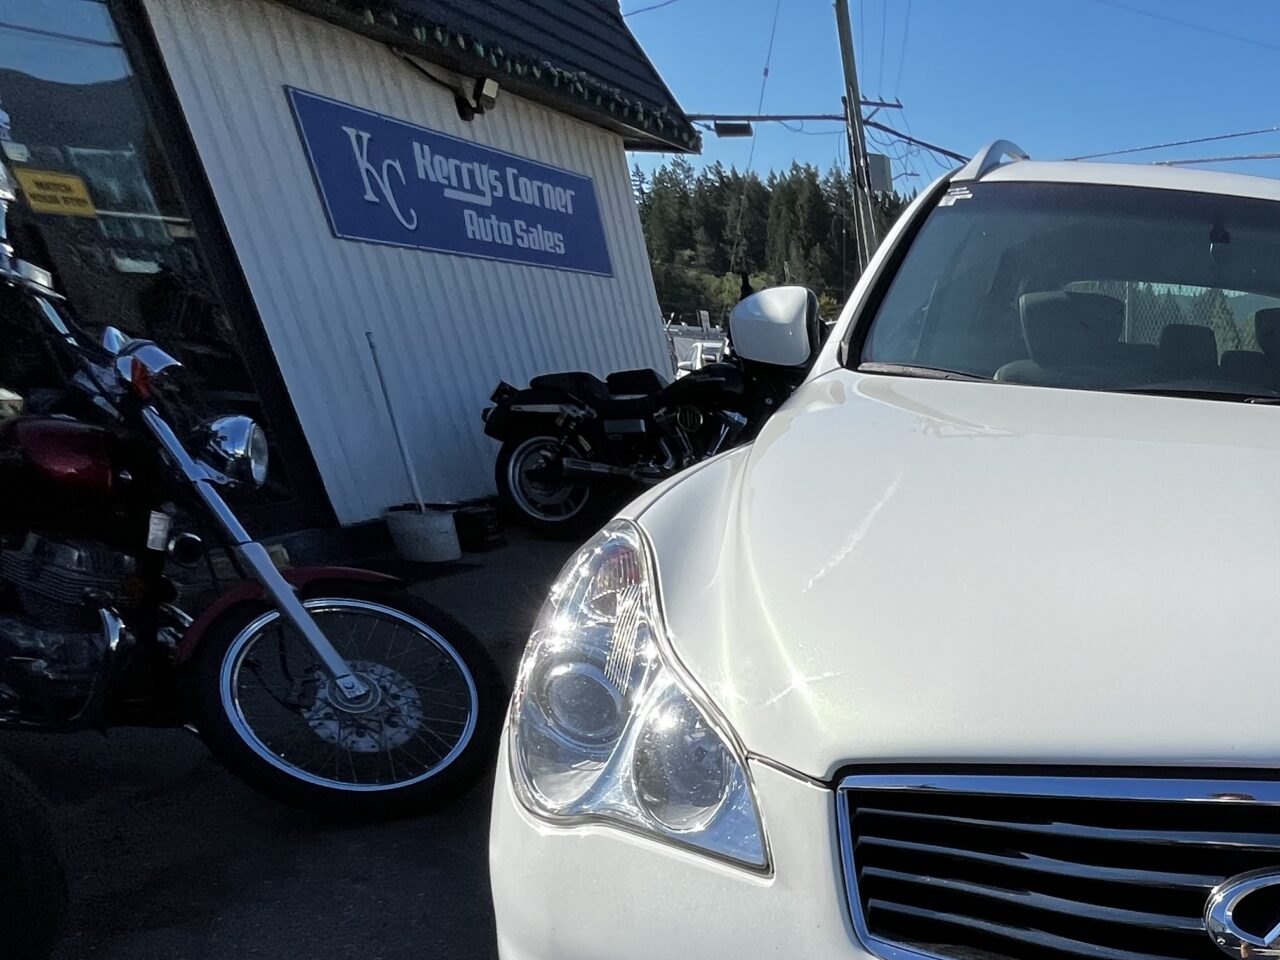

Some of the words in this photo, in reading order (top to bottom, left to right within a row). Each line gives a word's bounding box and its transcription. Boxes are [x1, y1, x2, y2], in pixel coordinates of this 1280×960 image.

[412, 141, 503, 206] Kerrys
[506, 167, 575, 215] Corner
[463, 209, 513, 246] Auto
[516, 219, 566, 255] Sales
